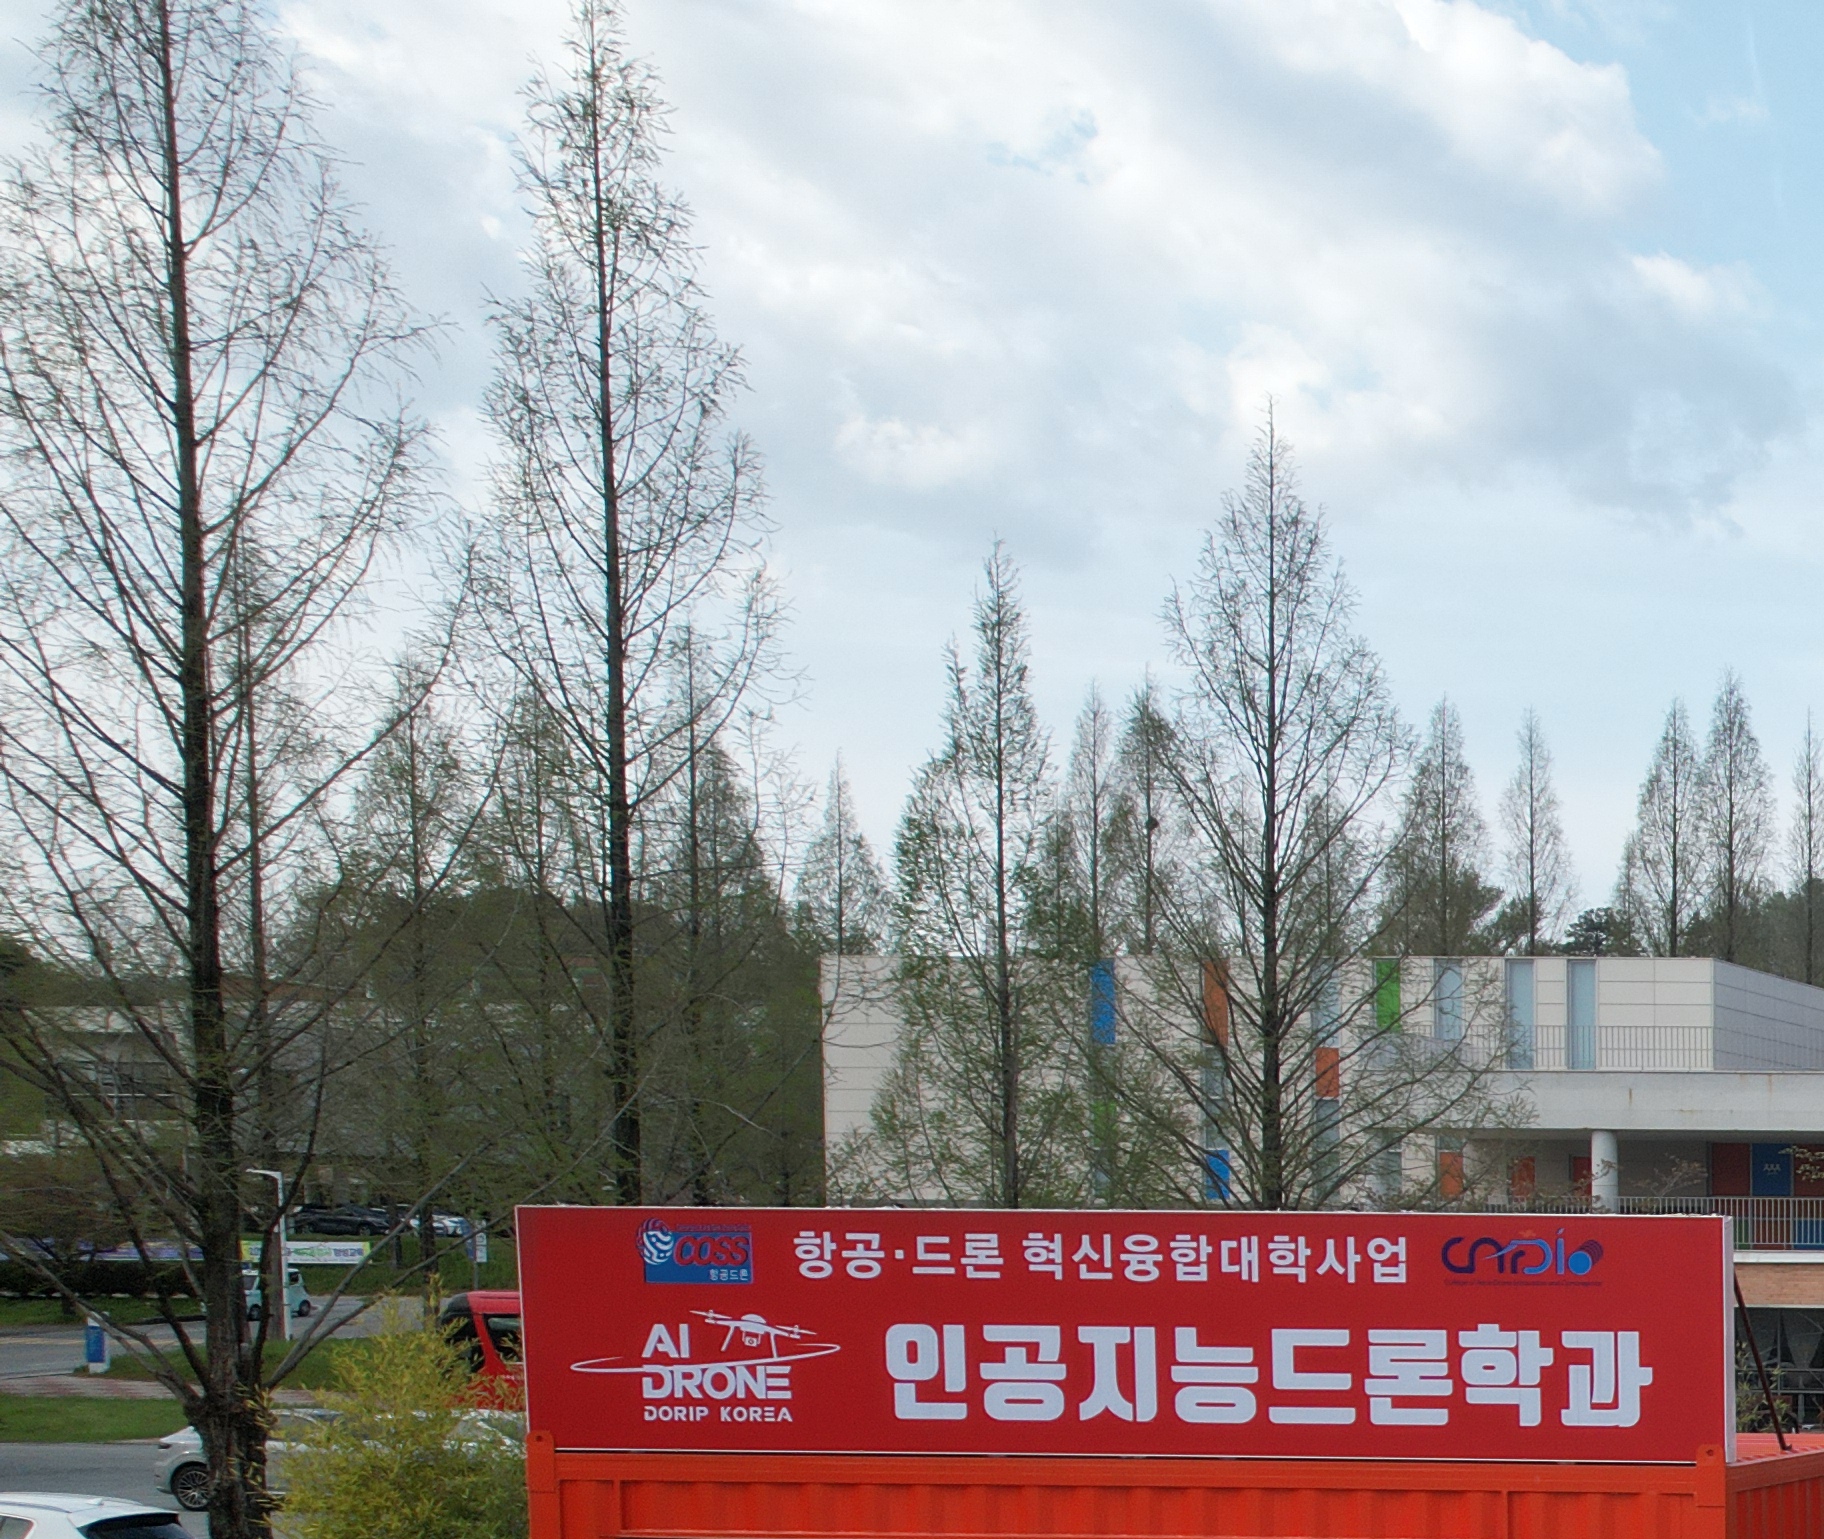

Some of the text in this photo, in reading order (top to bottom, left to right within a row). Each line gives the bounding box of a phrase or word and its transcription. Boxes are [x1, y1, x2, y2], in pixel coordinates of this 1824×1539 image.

[674, 1236, 749, 1266] COSS
[793, 1230, 1407, 1284] 항공·드론 혁신융합대학사업
[709, 1268, 749, 1281] 항공드론
[641, 1323, 690, 1358] AI
[642, 1364, 792, 1400] DRONE
[885, 1322, 1653, 1427] 인공지능드론학과
[643, 1406, 793, 1422] DORIP KOREA
